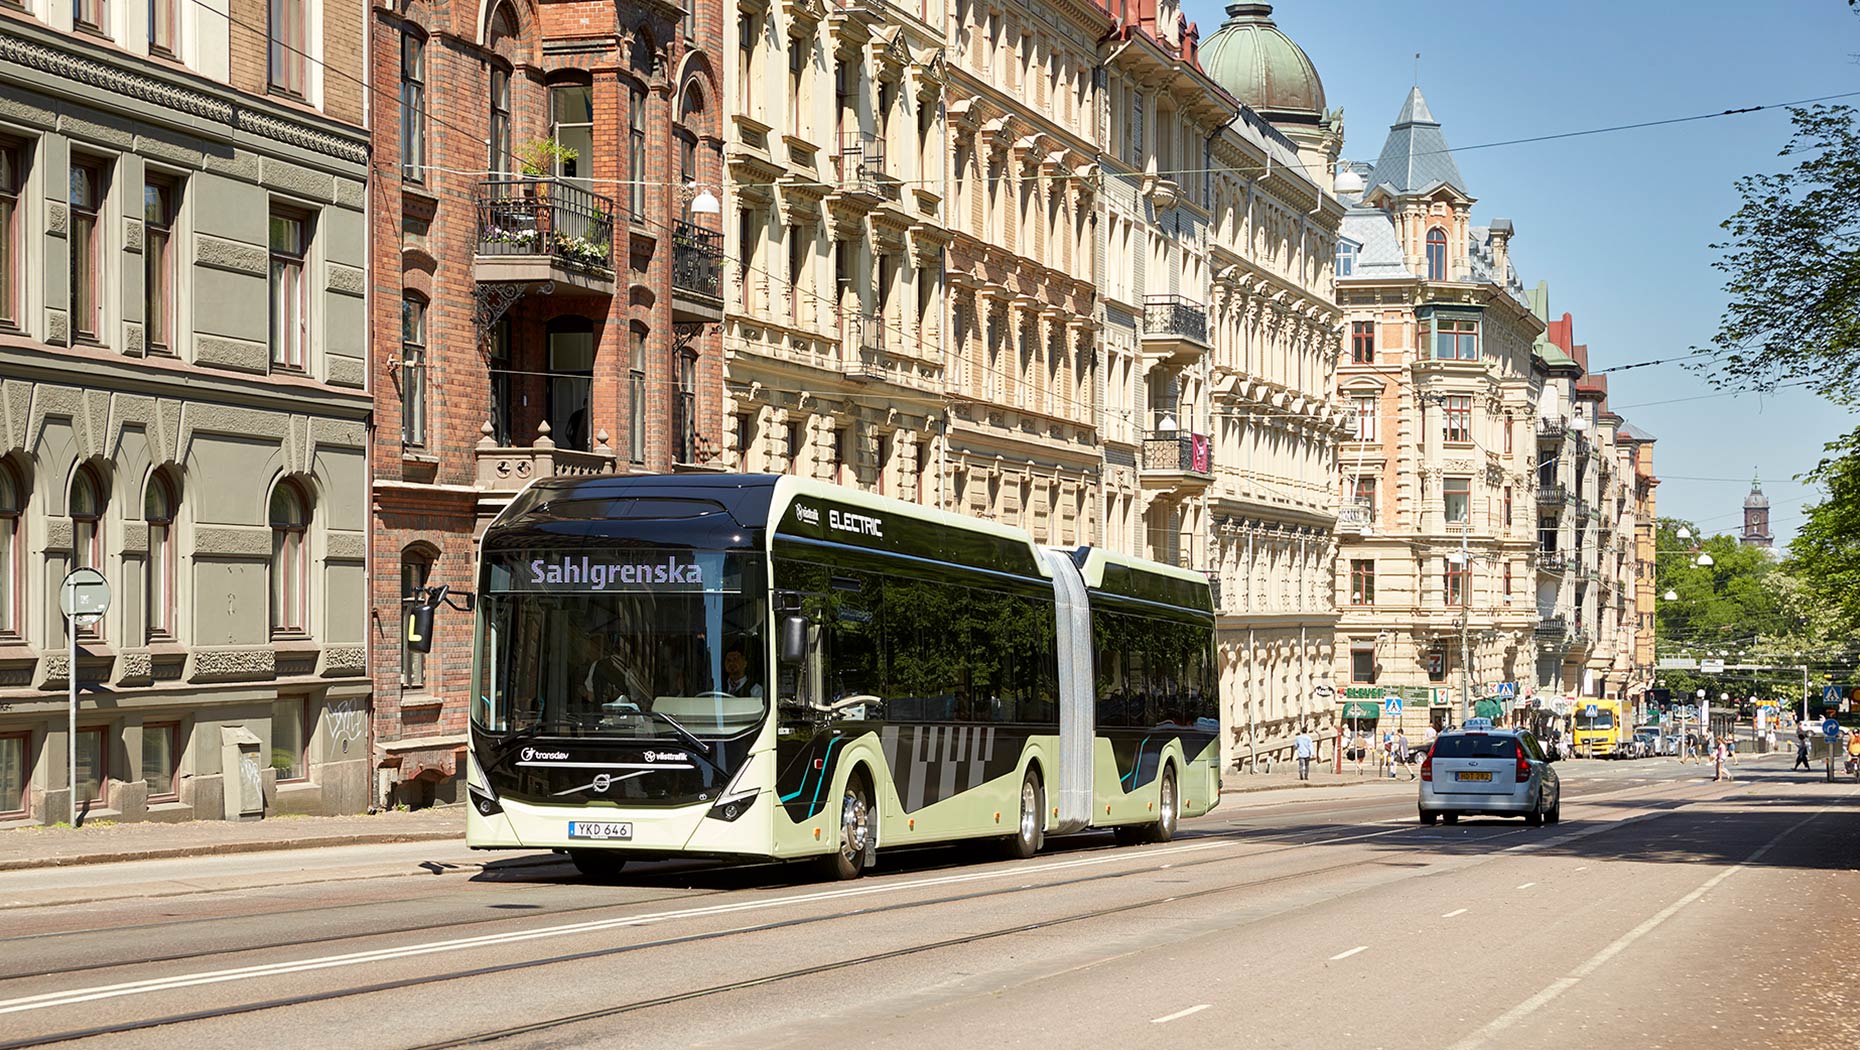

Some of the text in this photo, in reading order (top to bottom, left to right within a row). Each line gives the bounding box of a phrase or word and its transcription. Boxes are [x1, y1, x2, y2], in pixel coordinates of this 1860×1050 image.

[829, 509, 883, 537] ELECTRIC
[531, 556, 703, 590] Sahlgrenska
[578, 824, 627, 836] YKD 646
